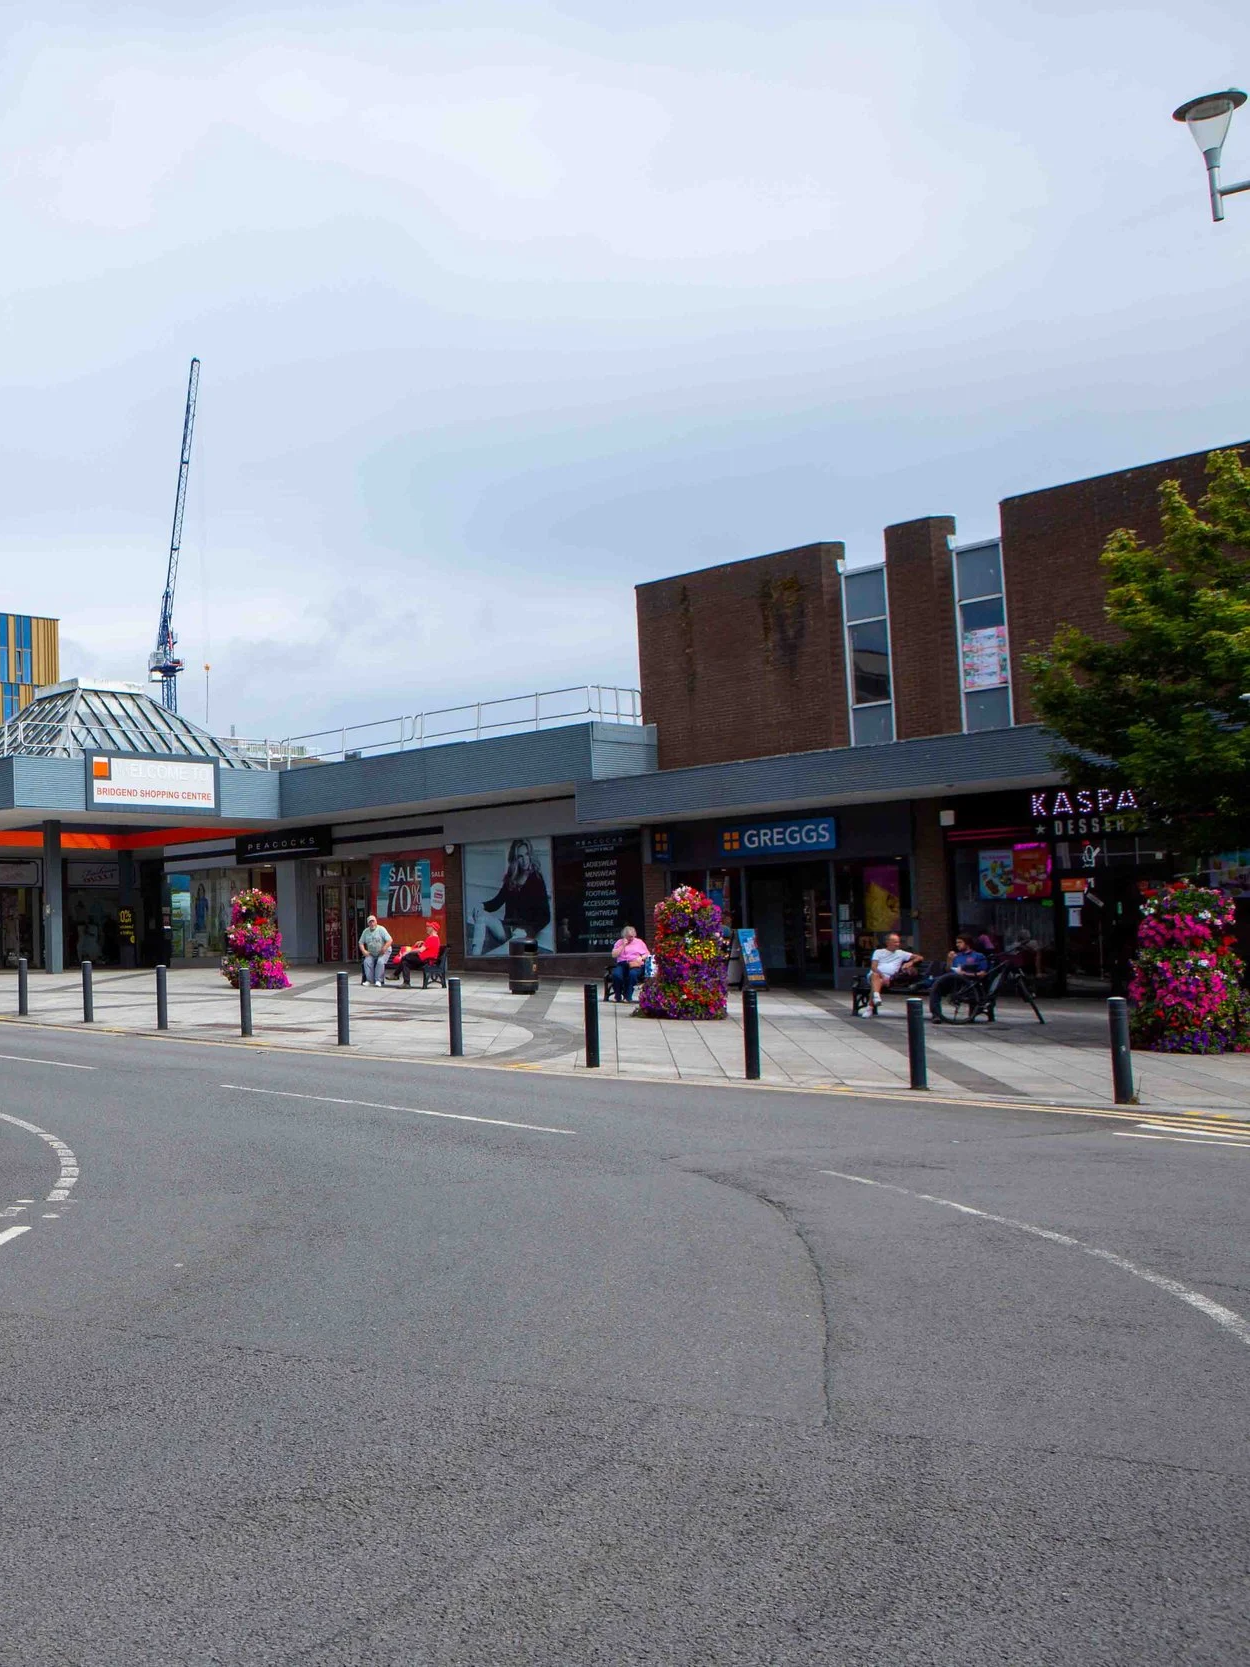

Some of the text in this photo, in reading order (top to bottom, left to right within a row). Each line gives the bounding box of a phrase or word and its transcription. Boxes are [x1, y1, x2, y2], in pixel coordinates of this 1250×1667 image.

[112, 762, 209, 782] WELCOME TO
[96, 787, 212, 801] BRIDGEND SHOPPING CENTRE
[744, 824, 831, 848] GREGGS
[247, 837, 316, 851] PEACOCKS
[583, 860, 618, 869] LADIESWEAR
[388, 866, 423, 882] SALE
[431, 870, 445, 878] SALE
[585, 869, 617, 878] MENSWEAR
[586, 879, 616, 888] KIDSWEAR
[585, 889, 617, 897] FOOTWEAR
[388, 884, 422, 913] 70%
[583, 899, 620, 907] ACCESSORIES
[585, 909, 618, 917] NIGHTWEAR
[590, 919, 615, 928] LINGERIE
